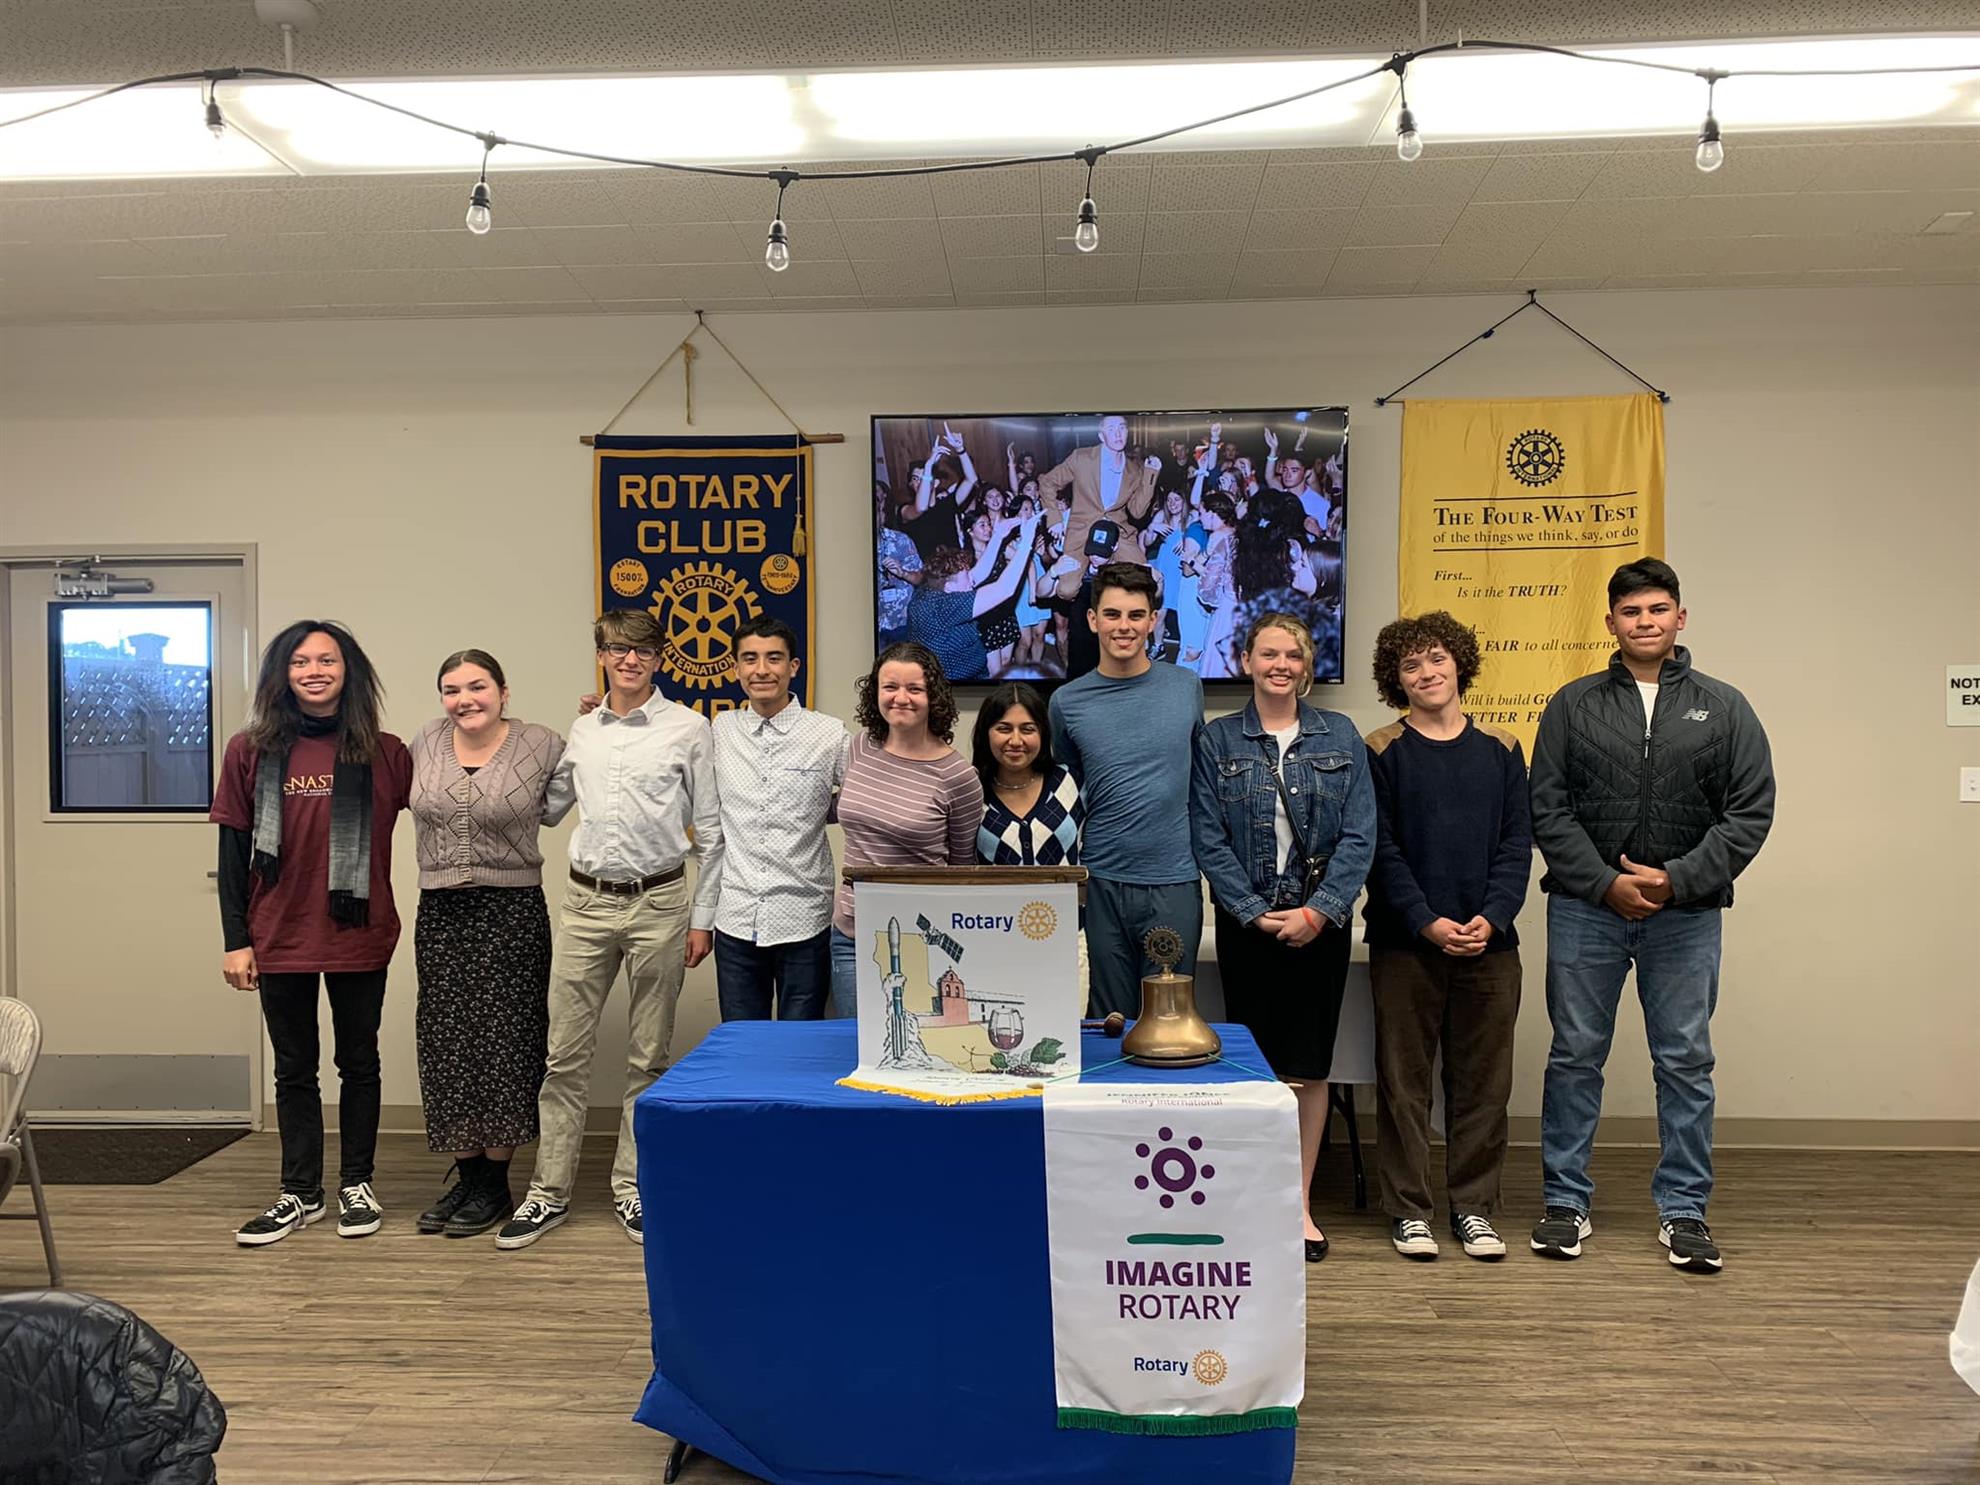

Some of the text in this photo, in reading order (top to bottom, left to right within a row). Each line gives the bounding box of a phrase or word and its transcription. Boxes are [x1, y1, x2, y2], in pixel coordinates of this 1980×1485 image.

[619, 474, 793, 509] ROTARY
[637, 520, 766, 553] CLUB
[1433, 526, 1639, 545] of the things we think, say, or do
[616, 572, 643, 582] 1500%
[674, 576, 734, 594] ROTARY
[1434, 571, 1472, 581] First...
[1458, 585, 1568, 598] Is it the TRUTH?
[1485, 640, 1520, 652] FAIR
[1525, 640, 1538, 651] to
[1542, 639, 1560, 651] all
[1562, 640, 1620, 650] concerne
[1951, 678, 1980, 689] NOT
[1485, 694, 1494, 706] it
[1498, 693, 1530, 705] build
[952, 913, 1014, 931] Rotary
[1106, 1260, 1251, 1287] IMAGINE
[1119, 1294, 1241, 1320] ROTARY
[1134, 1357, 1188, 1376] Rotary
